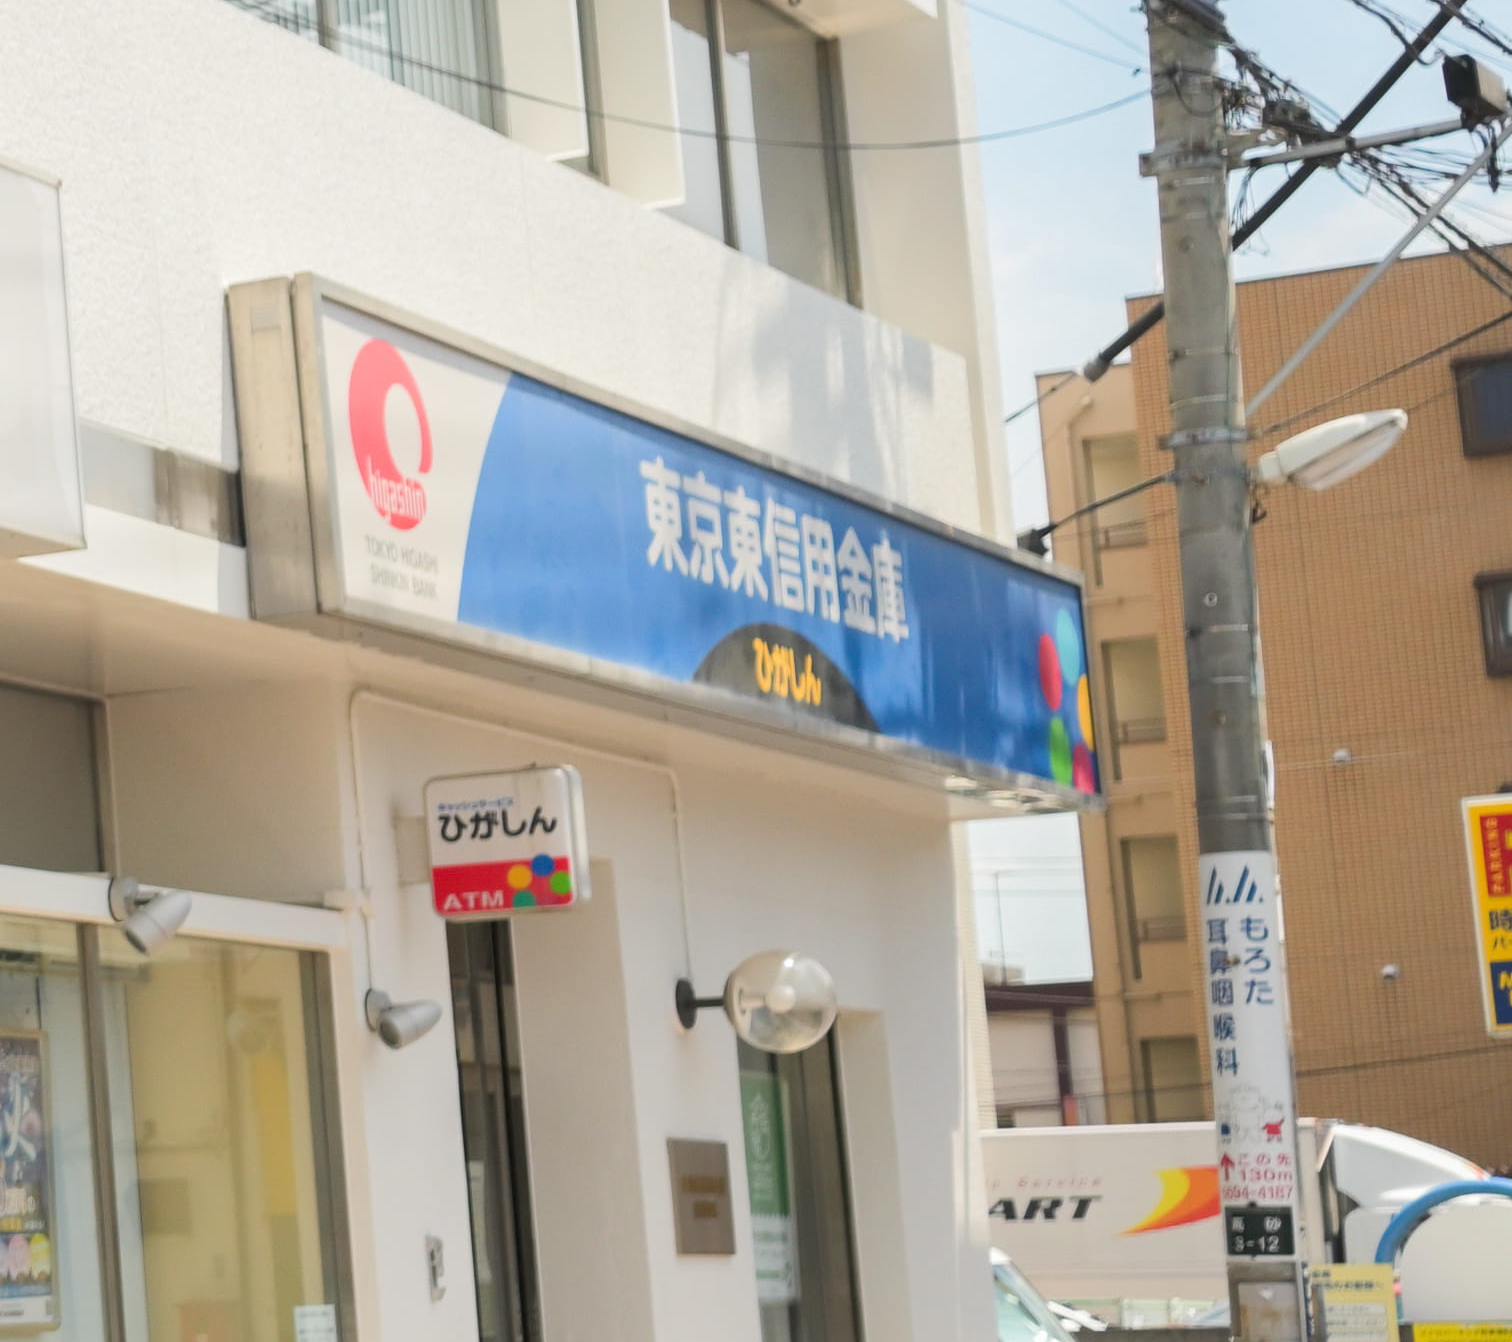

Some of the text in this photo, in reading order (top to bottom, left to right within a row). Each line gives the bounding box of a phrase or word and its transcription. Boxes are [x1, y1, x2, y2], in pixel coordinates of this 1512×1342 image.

[639, 455, 910, 644] 東京東信用金庫
[753, 637, 822, 706] ひがしん
[438, 806, 558, 843] ひがしん
[443, 890, 504, 910] ATM
[1206, 917, 1239, 1077] 耳鼻咽喉科
[1239, 916, 1275, 1005] もろた
